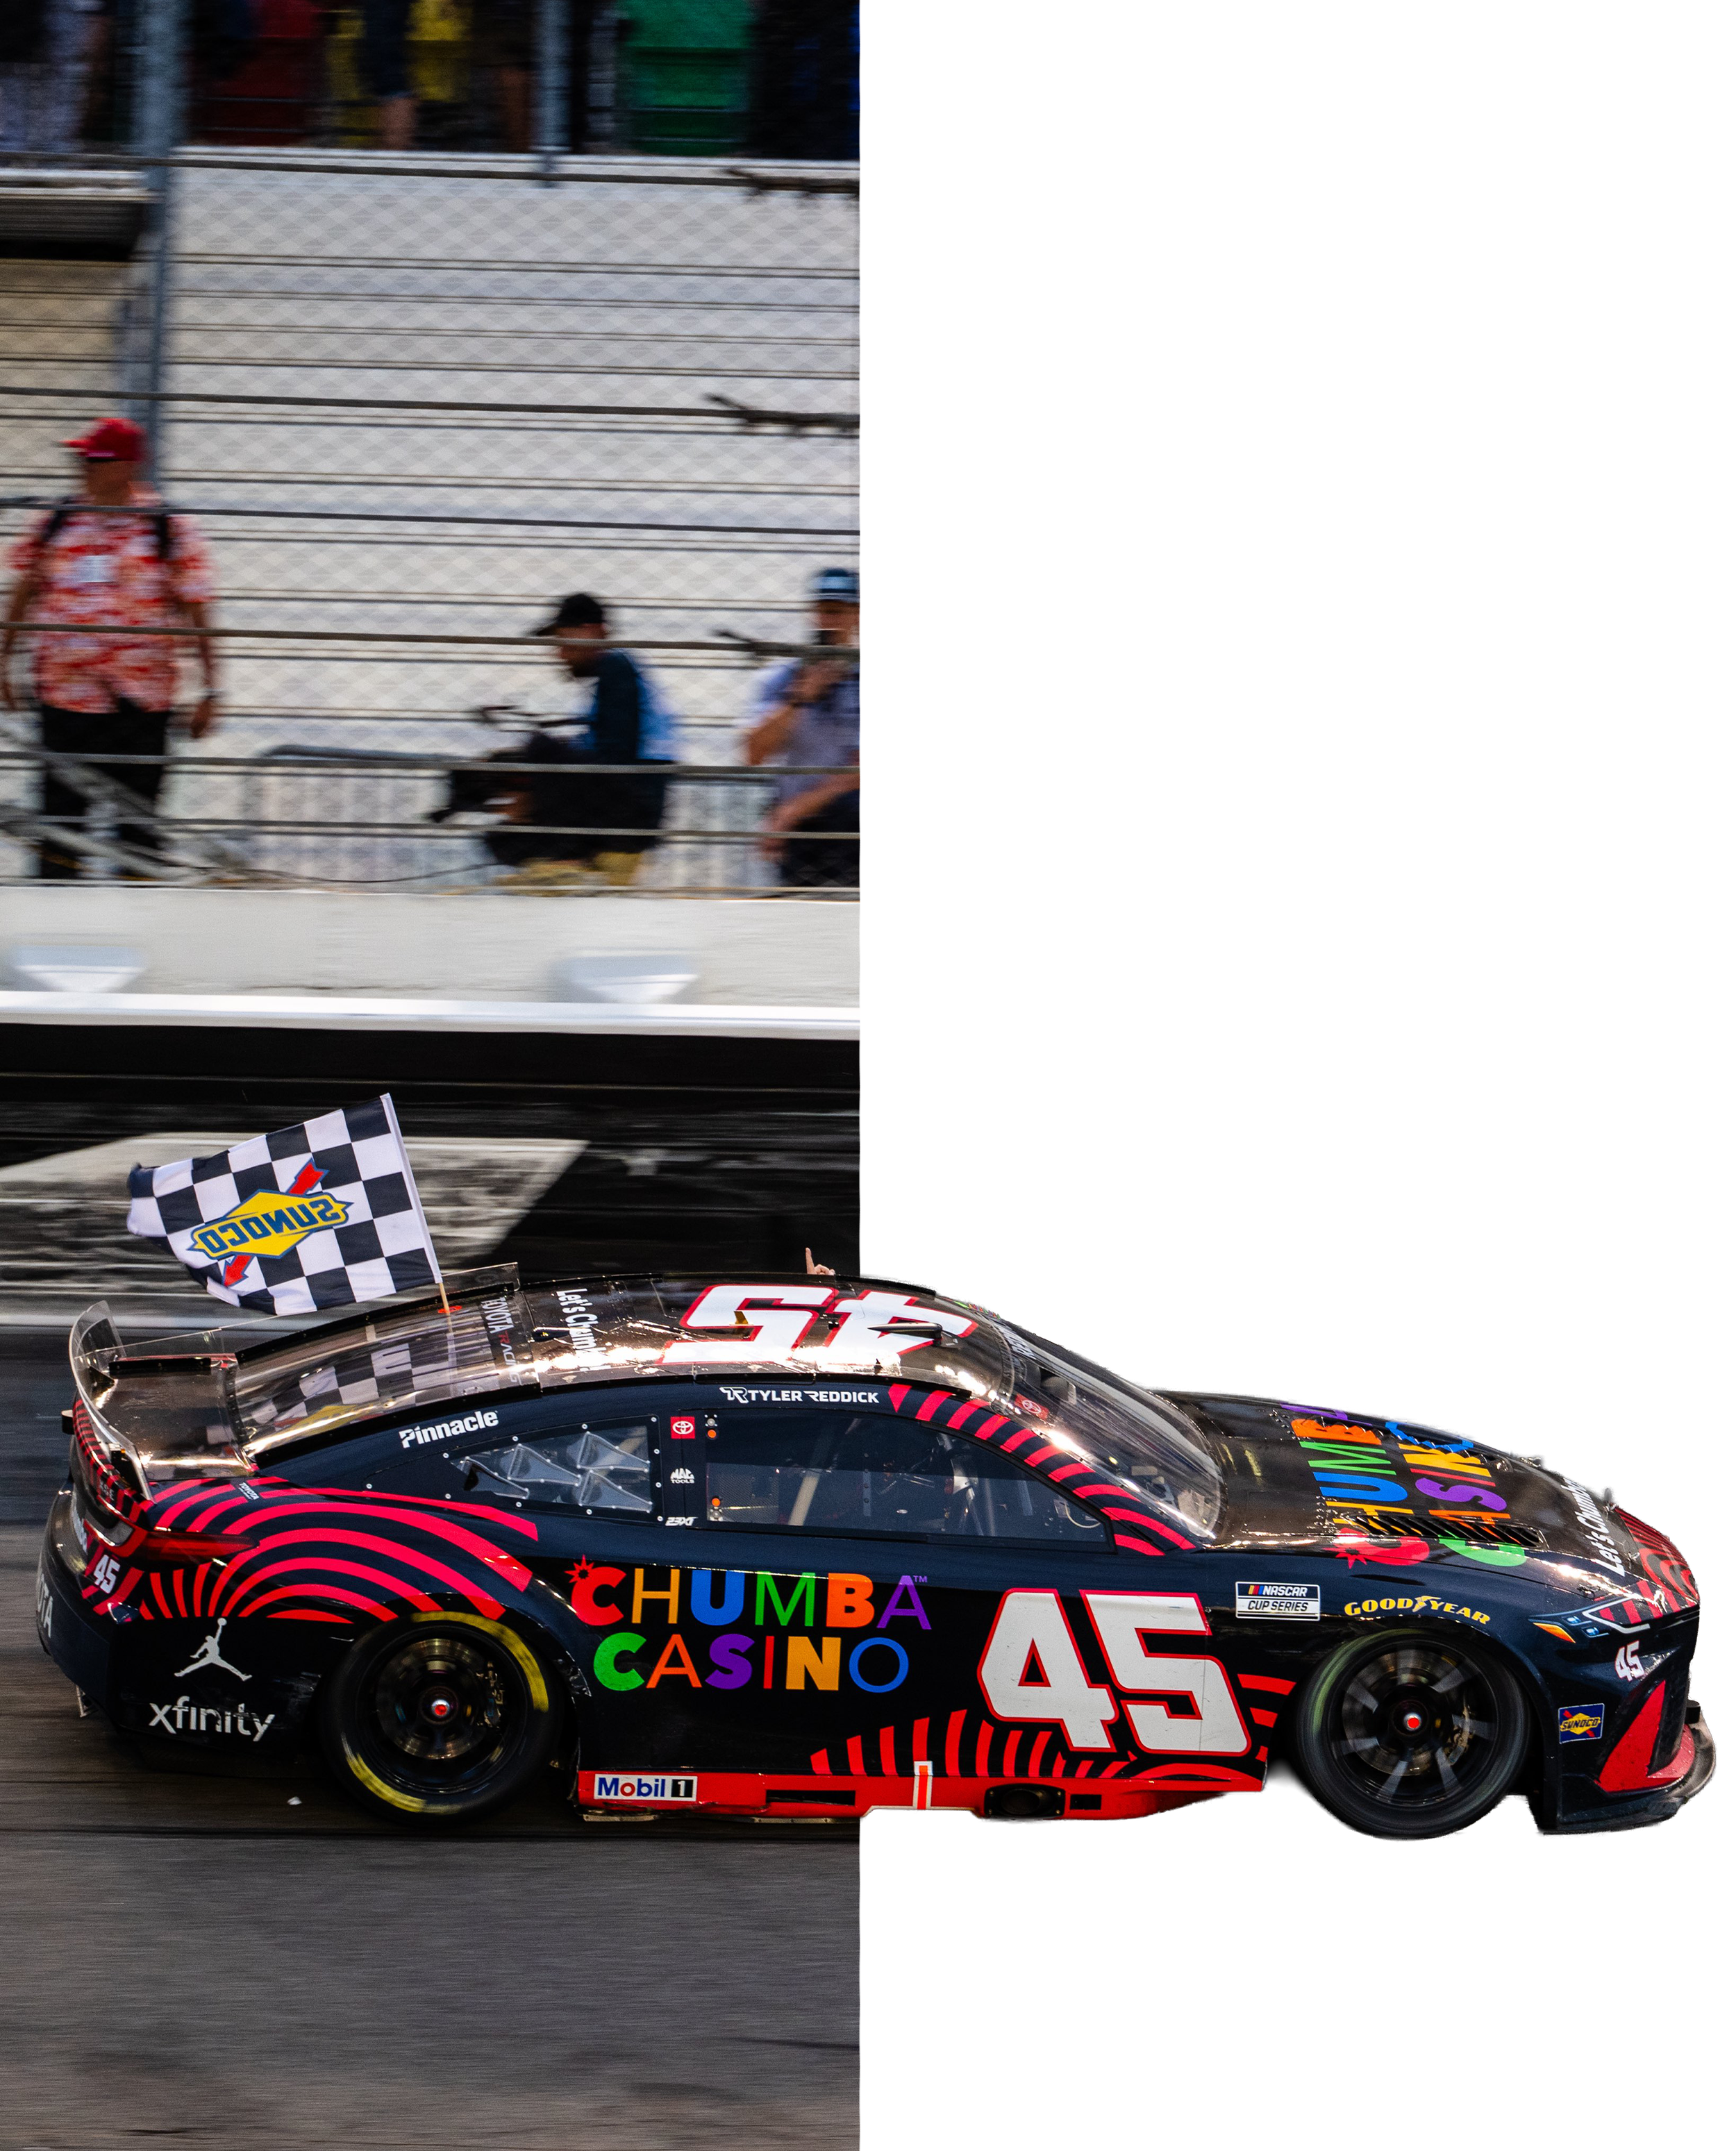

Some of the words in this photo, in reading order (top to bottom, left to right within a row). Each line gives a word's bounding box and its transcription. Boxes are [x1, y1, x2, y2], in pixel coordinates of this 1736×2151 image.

[481, 1296, 515, 1334] TOYOTA
[556, 1288, 593, 1314] Let's
[748, 1390, 803, 1402] TYLER
[803, 1391, 880, 1404] REDDICK
[399, 1411, 499, 1448] Pinnacle
[239, 1482, 260, 1500] TOYOTA
[670, 1468, 694, 1479] MAC
[1561, 1478, 1610, 1534] Chumba
[1585, 1534, 1625, 1577] Let's
[94, 1555, 120, 1594] 45
[565, 1555, 932, 1630] CHUMBA
[1262, 1585, 1308, 1597] NASCAR
[1248, 1600, 1269, 1610] CUP
[1271, 1601, 1308, 1612] SERIES
[1344, 1596, 1490, 1625] GOODYEAR
[593, 1632, 909, 1693] CASINO
[976, 1587, 1251, 1757] 45
[1614, 1640, 1644, 1682] 45
[149, 1696, 275, 1741] xfinity
[1562, 1718, 1599, 1730] SUNOCO
[598, 1777, 665, 1797] Mobil
